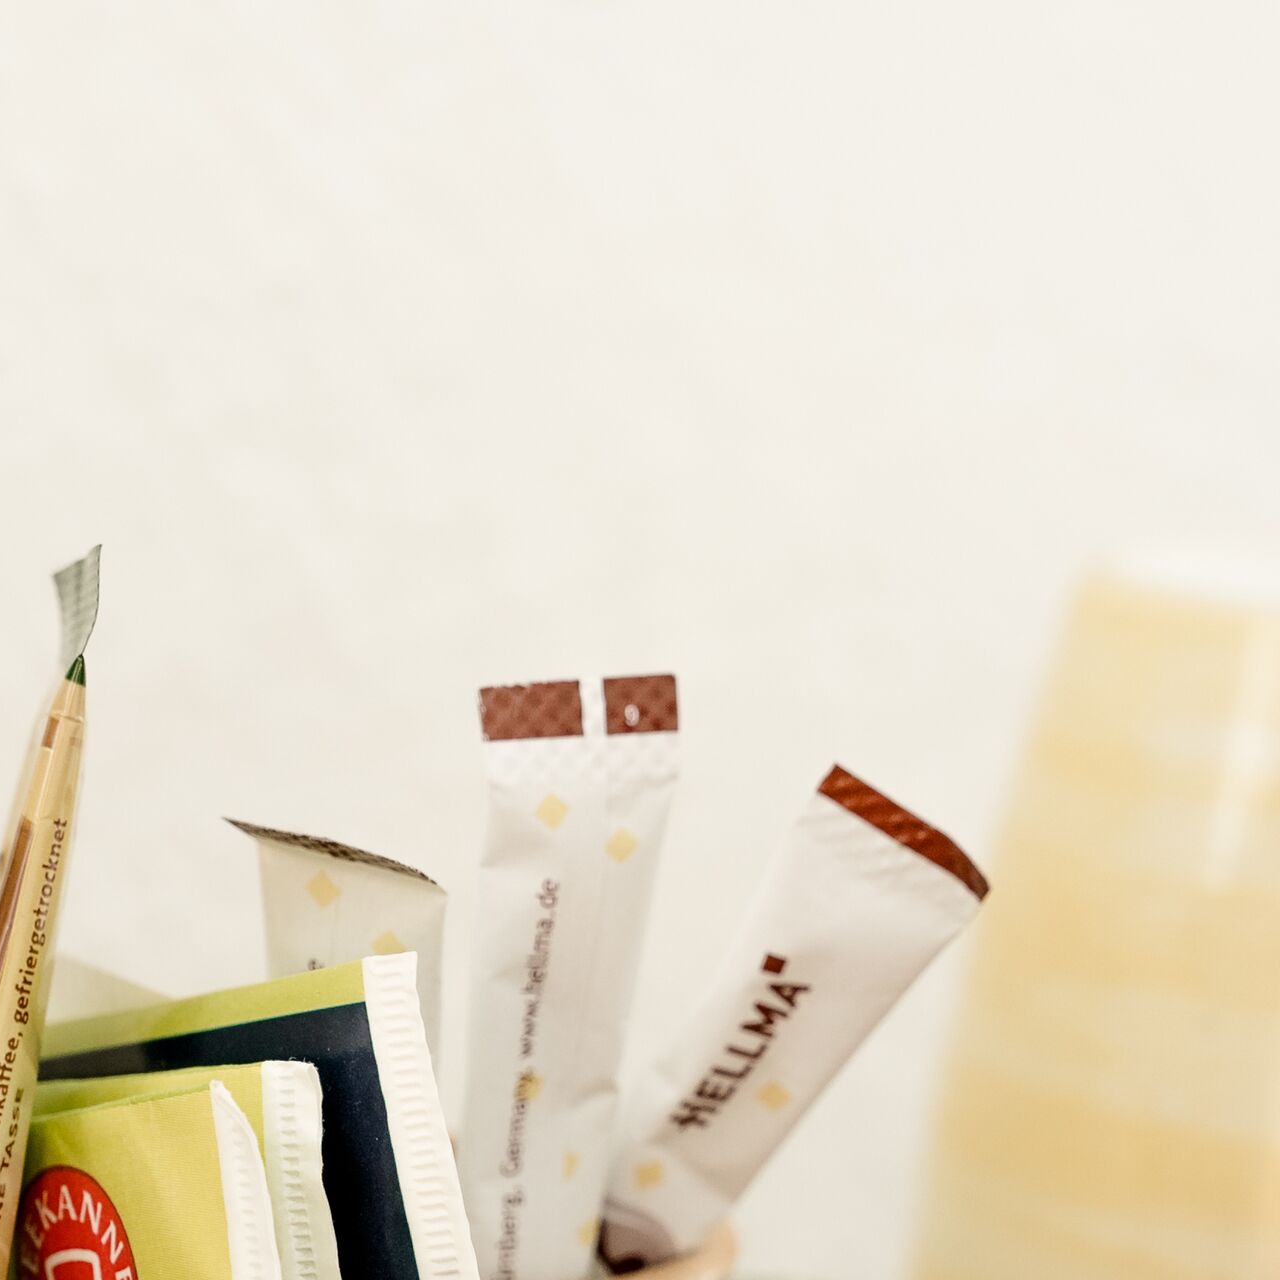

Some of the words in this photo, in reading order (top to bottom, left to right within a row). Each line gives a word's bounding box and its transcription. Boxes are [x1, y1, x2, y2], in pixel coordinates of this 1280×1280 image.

[14, 817, 68, 1026] gefriergetrocknet
[519, 877, 559, 1059] www.hellma.de
[0, 1087, 25, 1173] TASSE
[672, 983, 811, 1130] HELLMA
